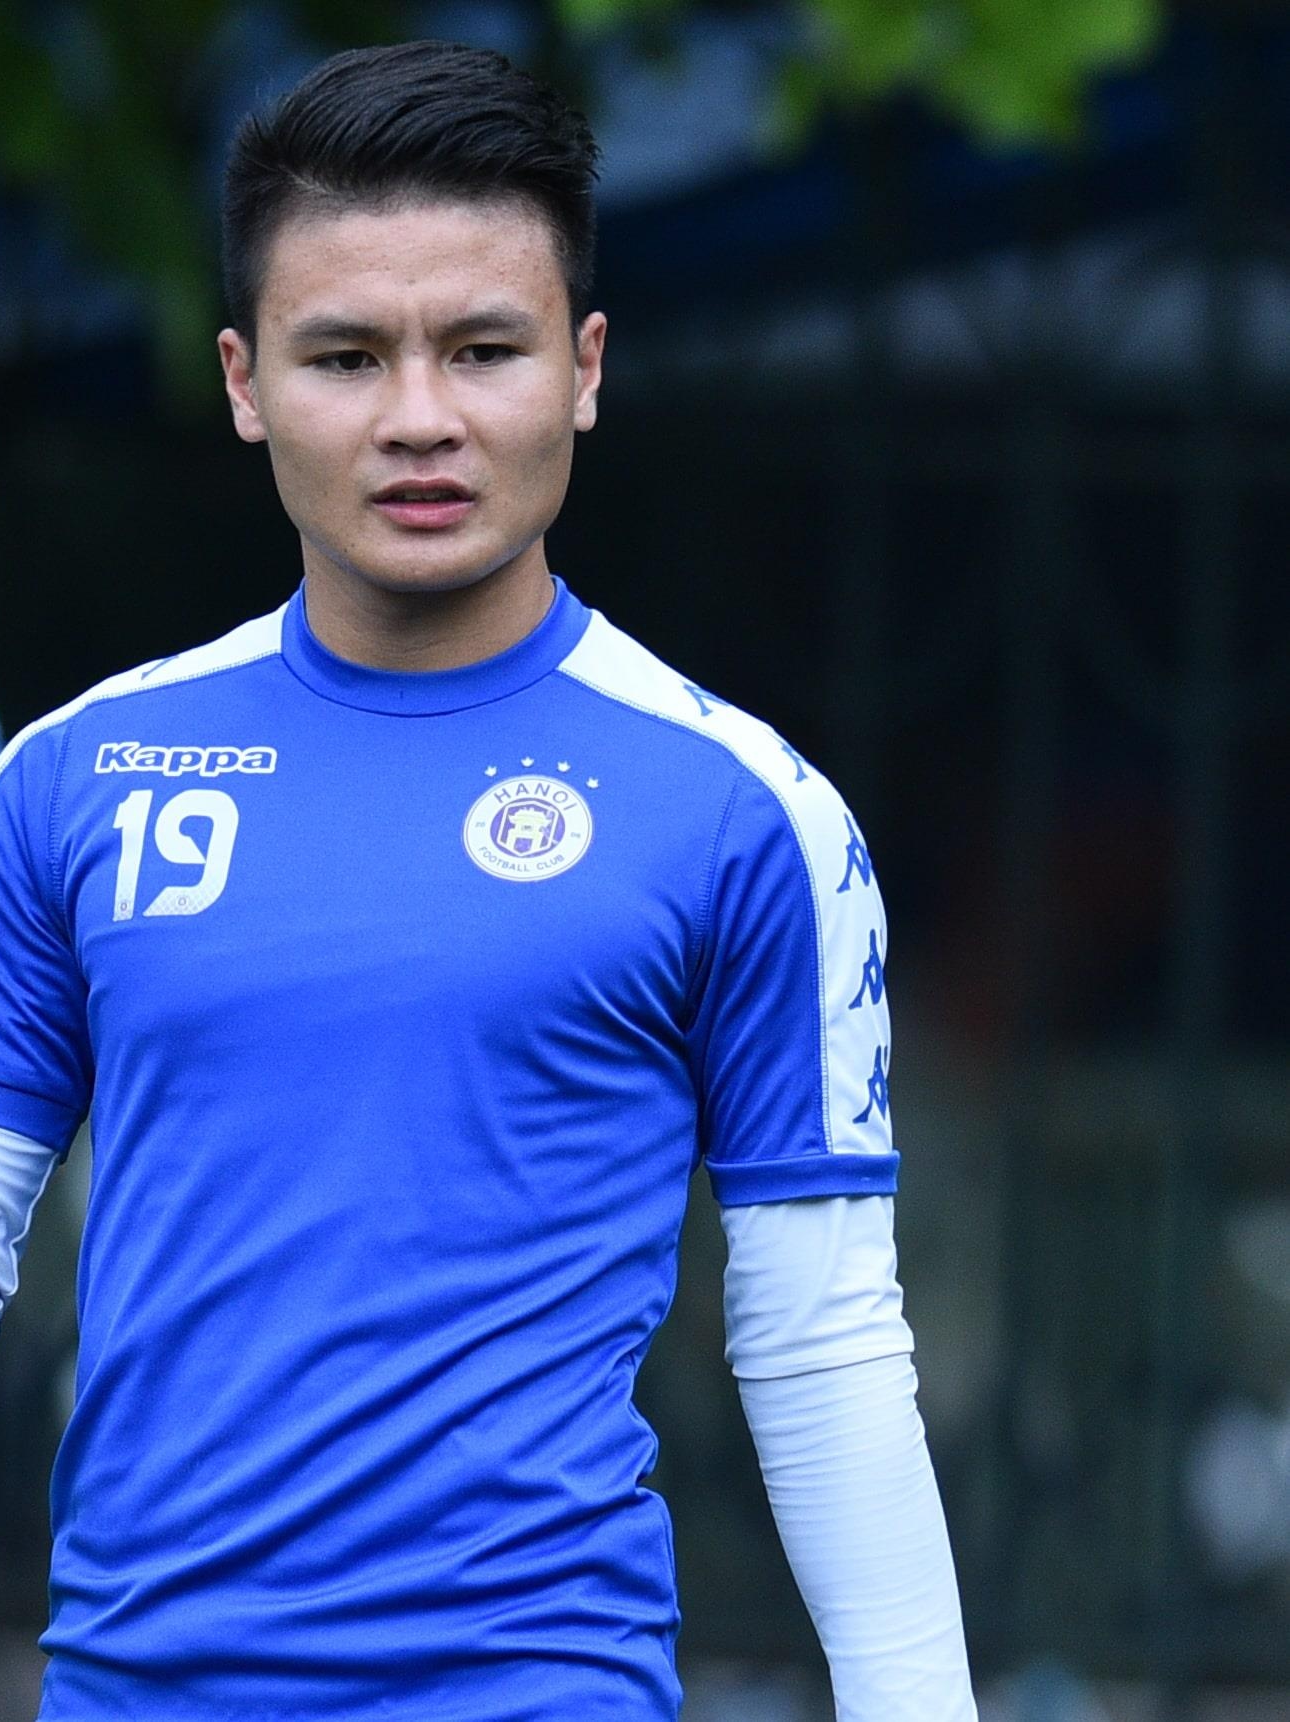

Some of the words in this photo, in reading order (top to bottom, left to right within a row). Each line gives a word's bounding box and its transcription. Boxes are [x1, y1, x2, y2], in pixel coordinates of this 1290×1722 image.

[94, 741, 278, 777] Kappa
[494, 783, 577, 810] HANOI
[112, 788, 240, 922] 19
[479, 847, 530, 872] FOOTBALL
[537, 855, 564, 870] CLUB
